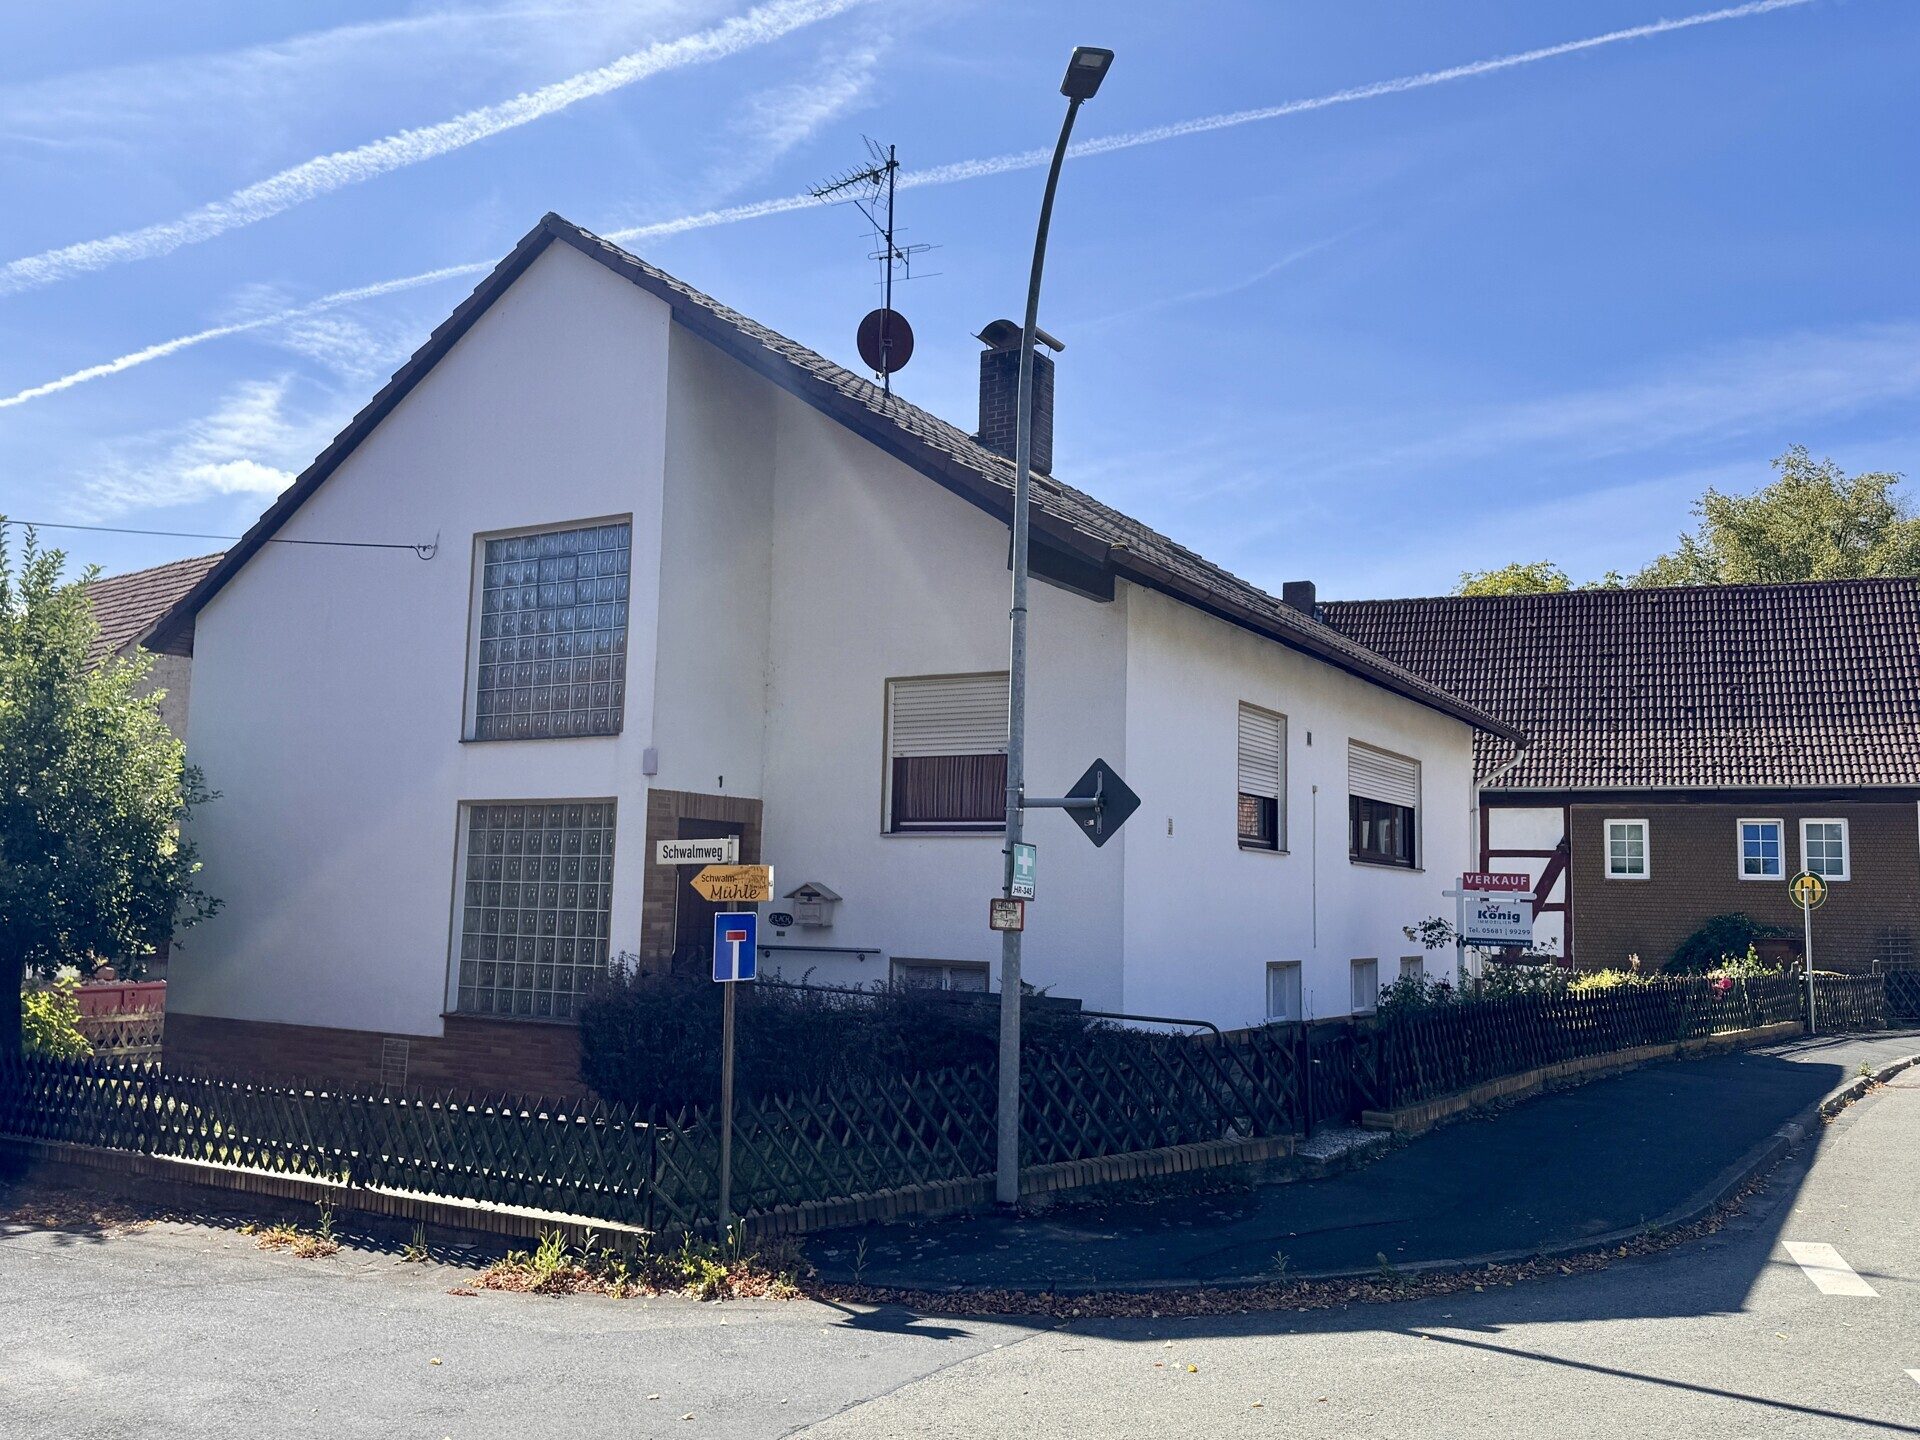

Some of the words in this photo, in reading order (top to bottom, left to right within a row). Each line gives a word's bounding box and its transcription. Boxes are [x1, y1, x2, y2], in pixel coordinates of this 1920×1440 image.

[718, 775, 723, 788] 1
[663, 845, 722, 861] Schwalmweg
[1466, 875, 1527, 885] VERKAUF
[710, 884, 760, 899] Mühle
[1477, 910, 1521, 923] König
